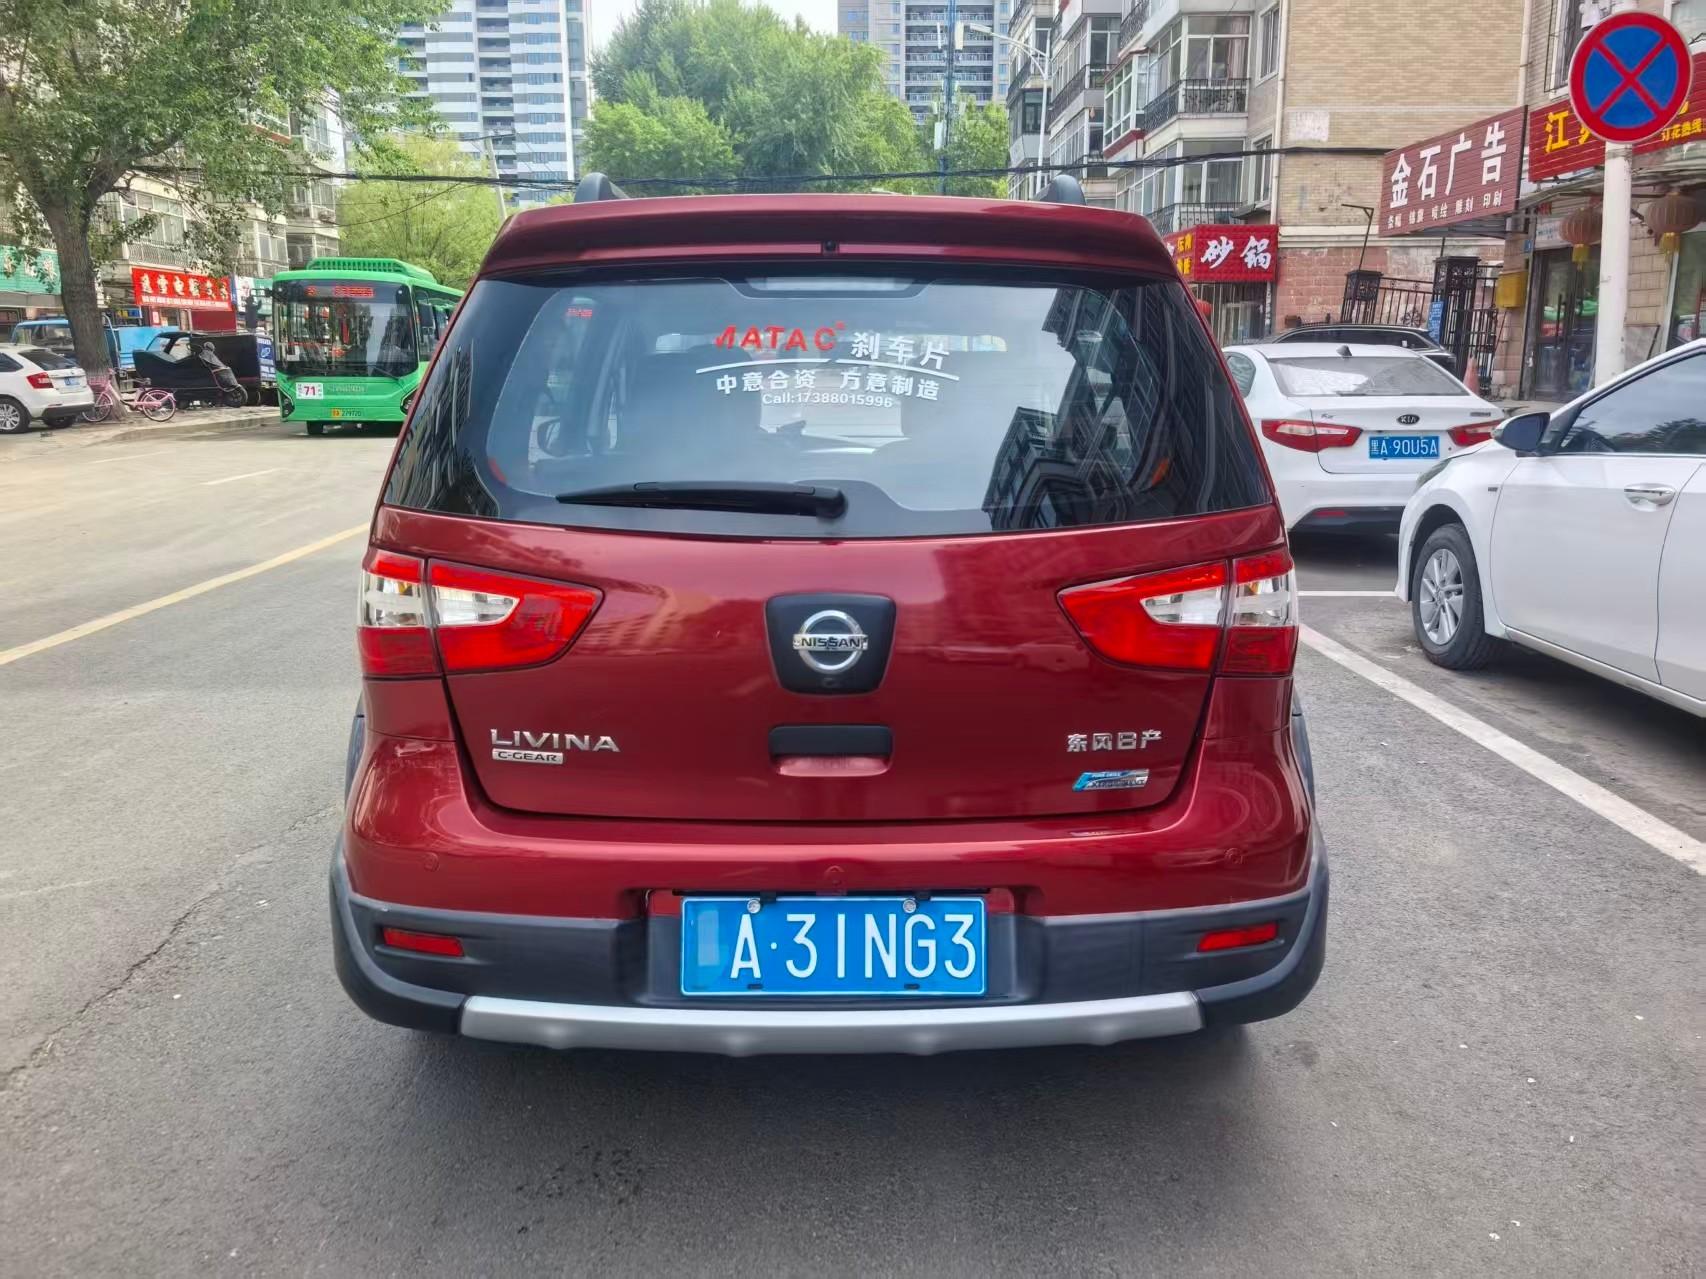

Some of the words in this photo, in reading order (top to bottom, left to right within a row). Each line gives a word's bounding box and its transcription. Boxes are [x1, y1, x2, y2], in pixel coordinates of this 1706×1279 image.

[1389, 121, 1507, 209] 金石广告
[1200, 235, 1272, 270] 砂锅
[851, 331, 951, 370] 刹车片
[303, 386, 316, 396] 71
[716, 369, 817, 395] 中意合资
[1400, 415, 1418, 424] KIA
[801, 637, 860, 647] NISSAN
[490, 728, 621, 752] LIVINA
[1066, 729, 1162, 753] 东风日产
[497, 750, 558, 762] C-GEAR
